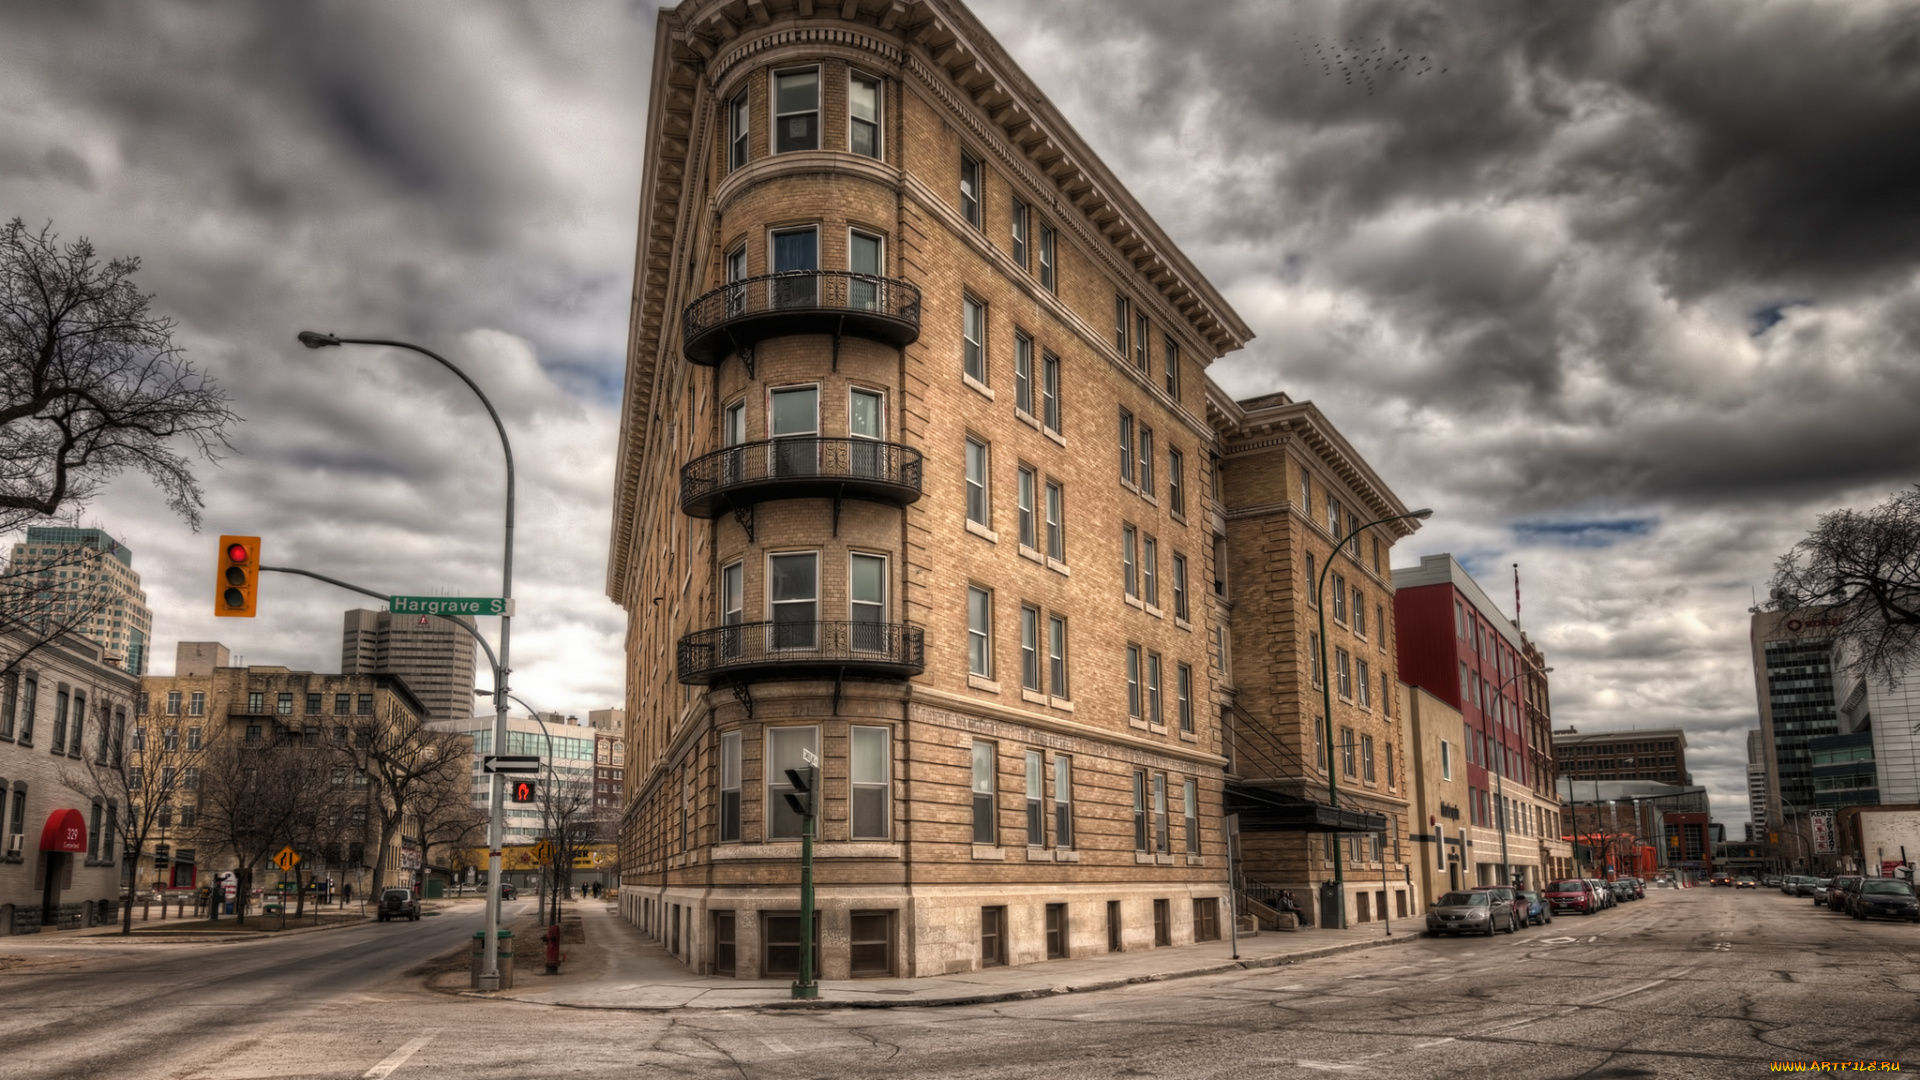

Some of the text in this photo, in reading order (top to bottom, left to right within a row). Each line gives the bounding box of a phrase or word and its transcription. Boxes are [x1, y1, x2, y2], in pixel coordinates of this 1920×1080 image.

[395, 598, 507, 614] Hargrave S
[67, 828, 79, 840] 329
